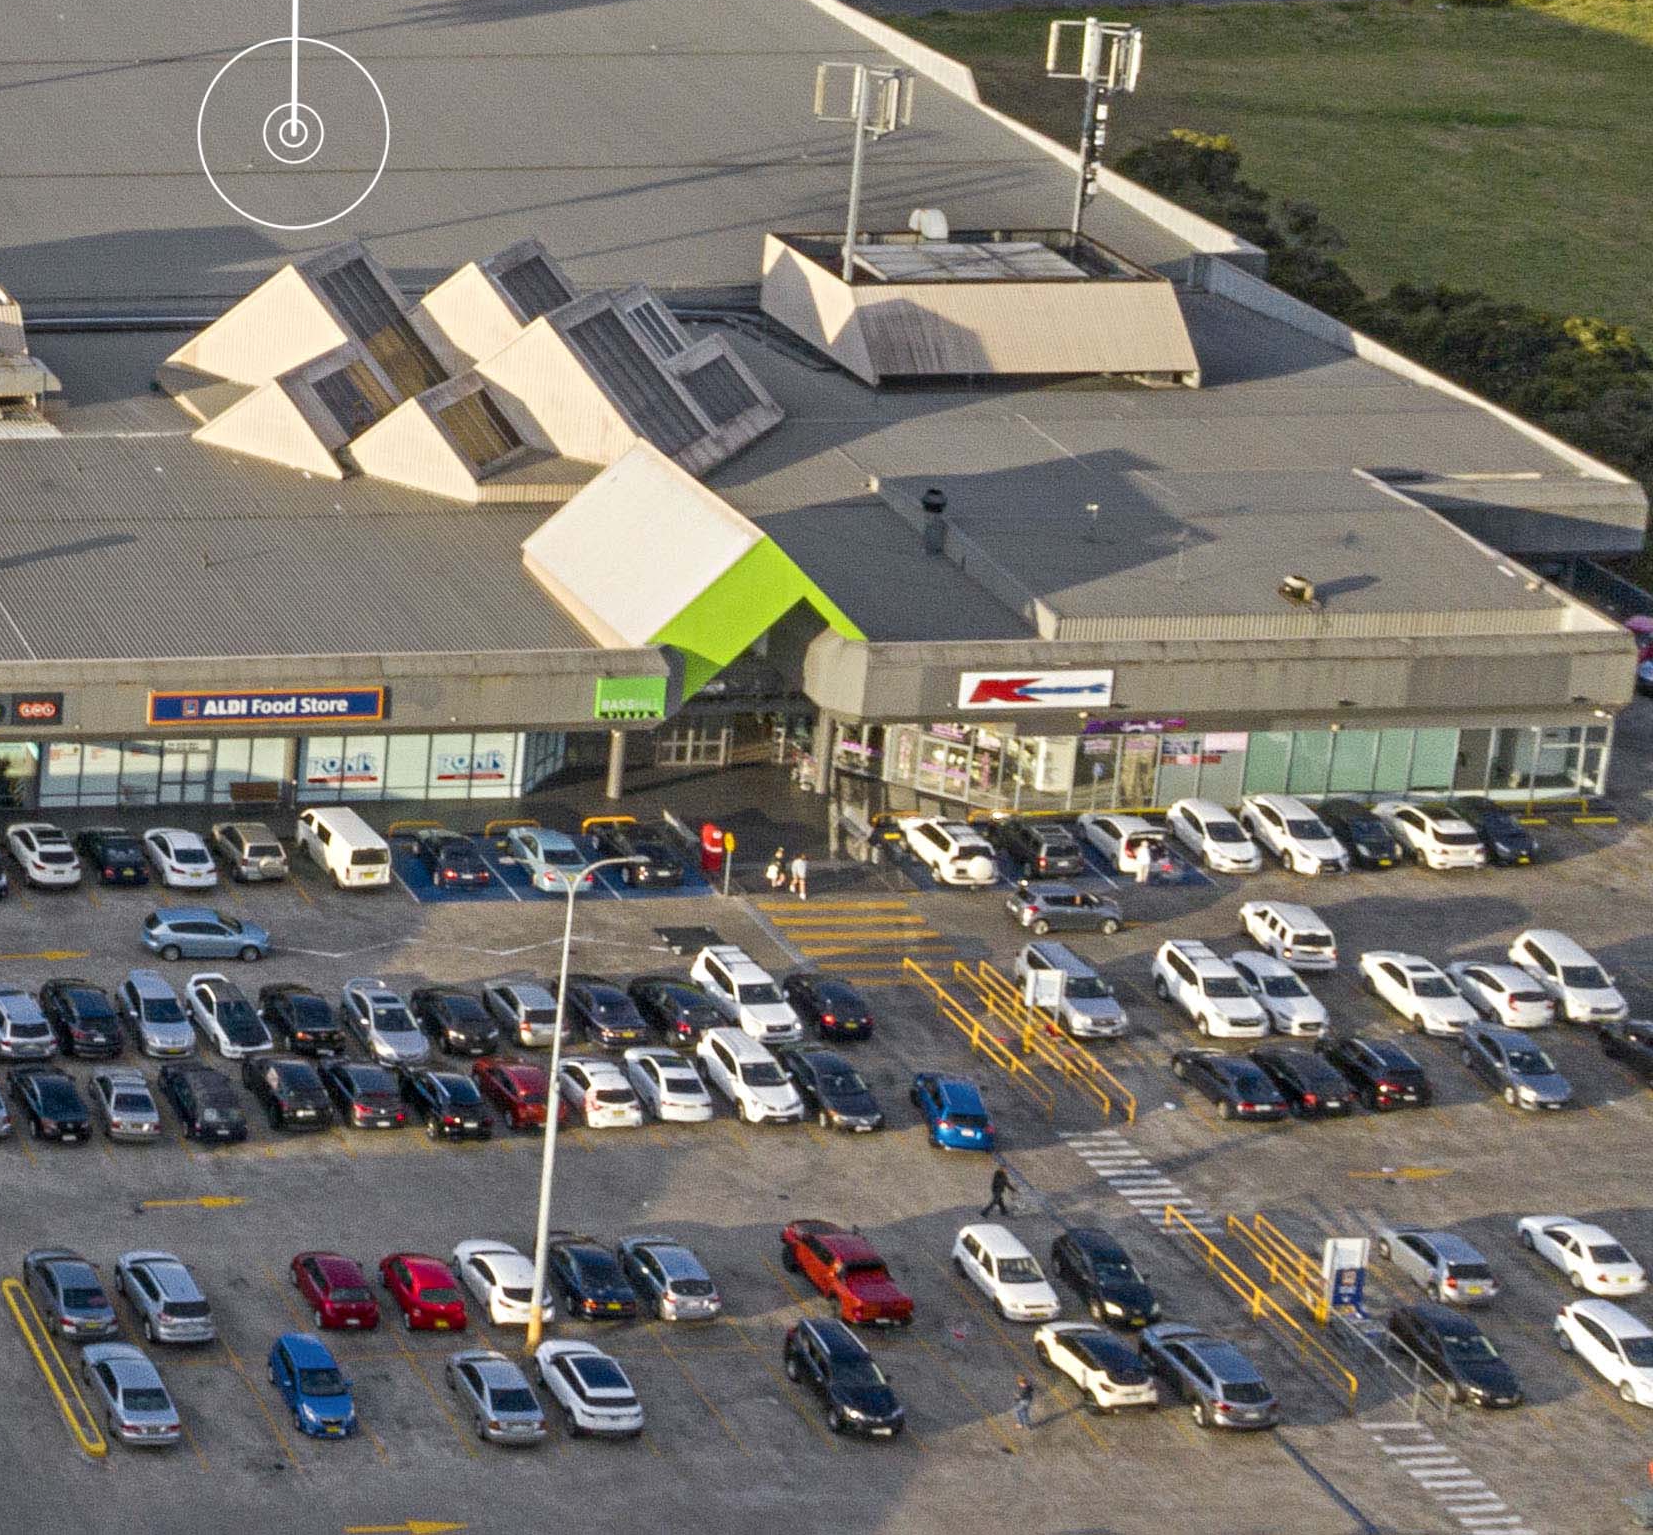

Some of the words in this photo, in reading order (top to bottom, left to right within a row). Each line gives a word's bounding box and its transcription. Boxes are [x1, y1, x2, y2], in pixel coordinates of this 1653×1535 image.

[203, 699, 247, 716] ALDI
[251, 696, 296, 714] Food
[300, 696, 349, 713] Store
